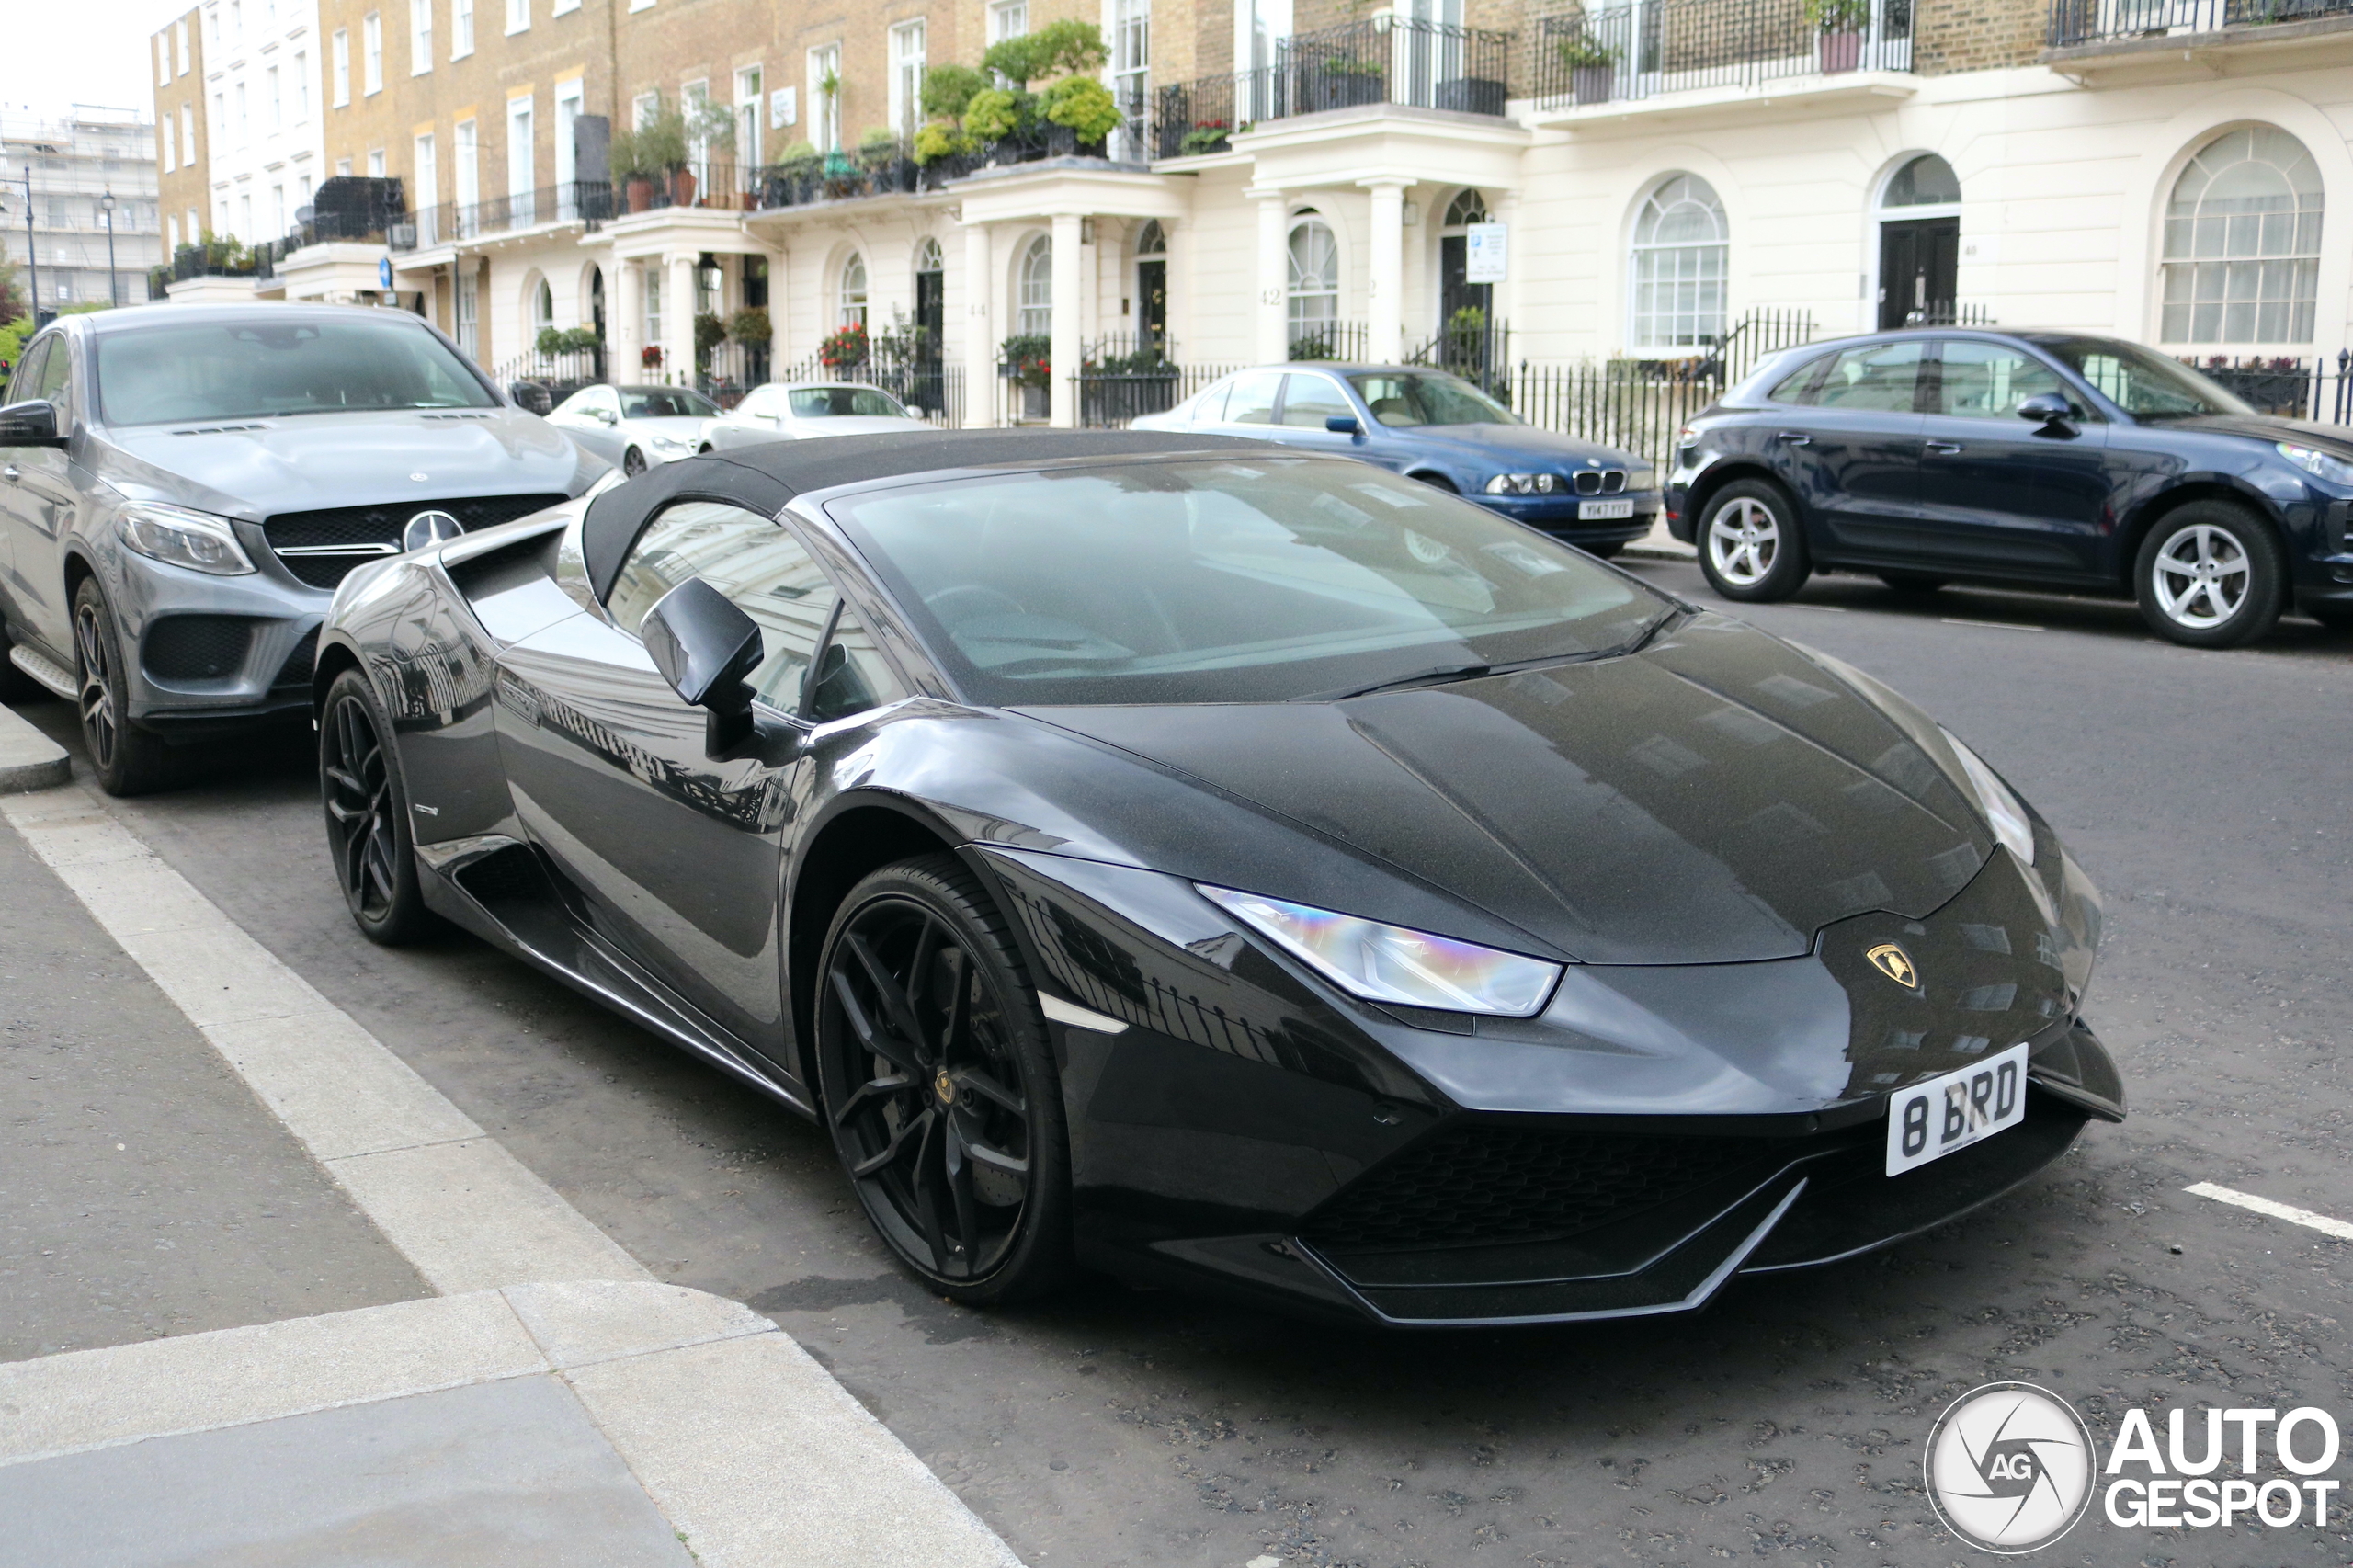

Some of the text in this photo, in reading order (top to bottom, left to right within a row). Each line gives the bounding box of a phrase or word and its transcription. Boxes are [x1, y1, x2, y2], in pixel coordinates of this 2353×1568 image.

[1259, 288, 1281, 305] 42
[1902, 1060, 2018, 1158] 8 BRD
